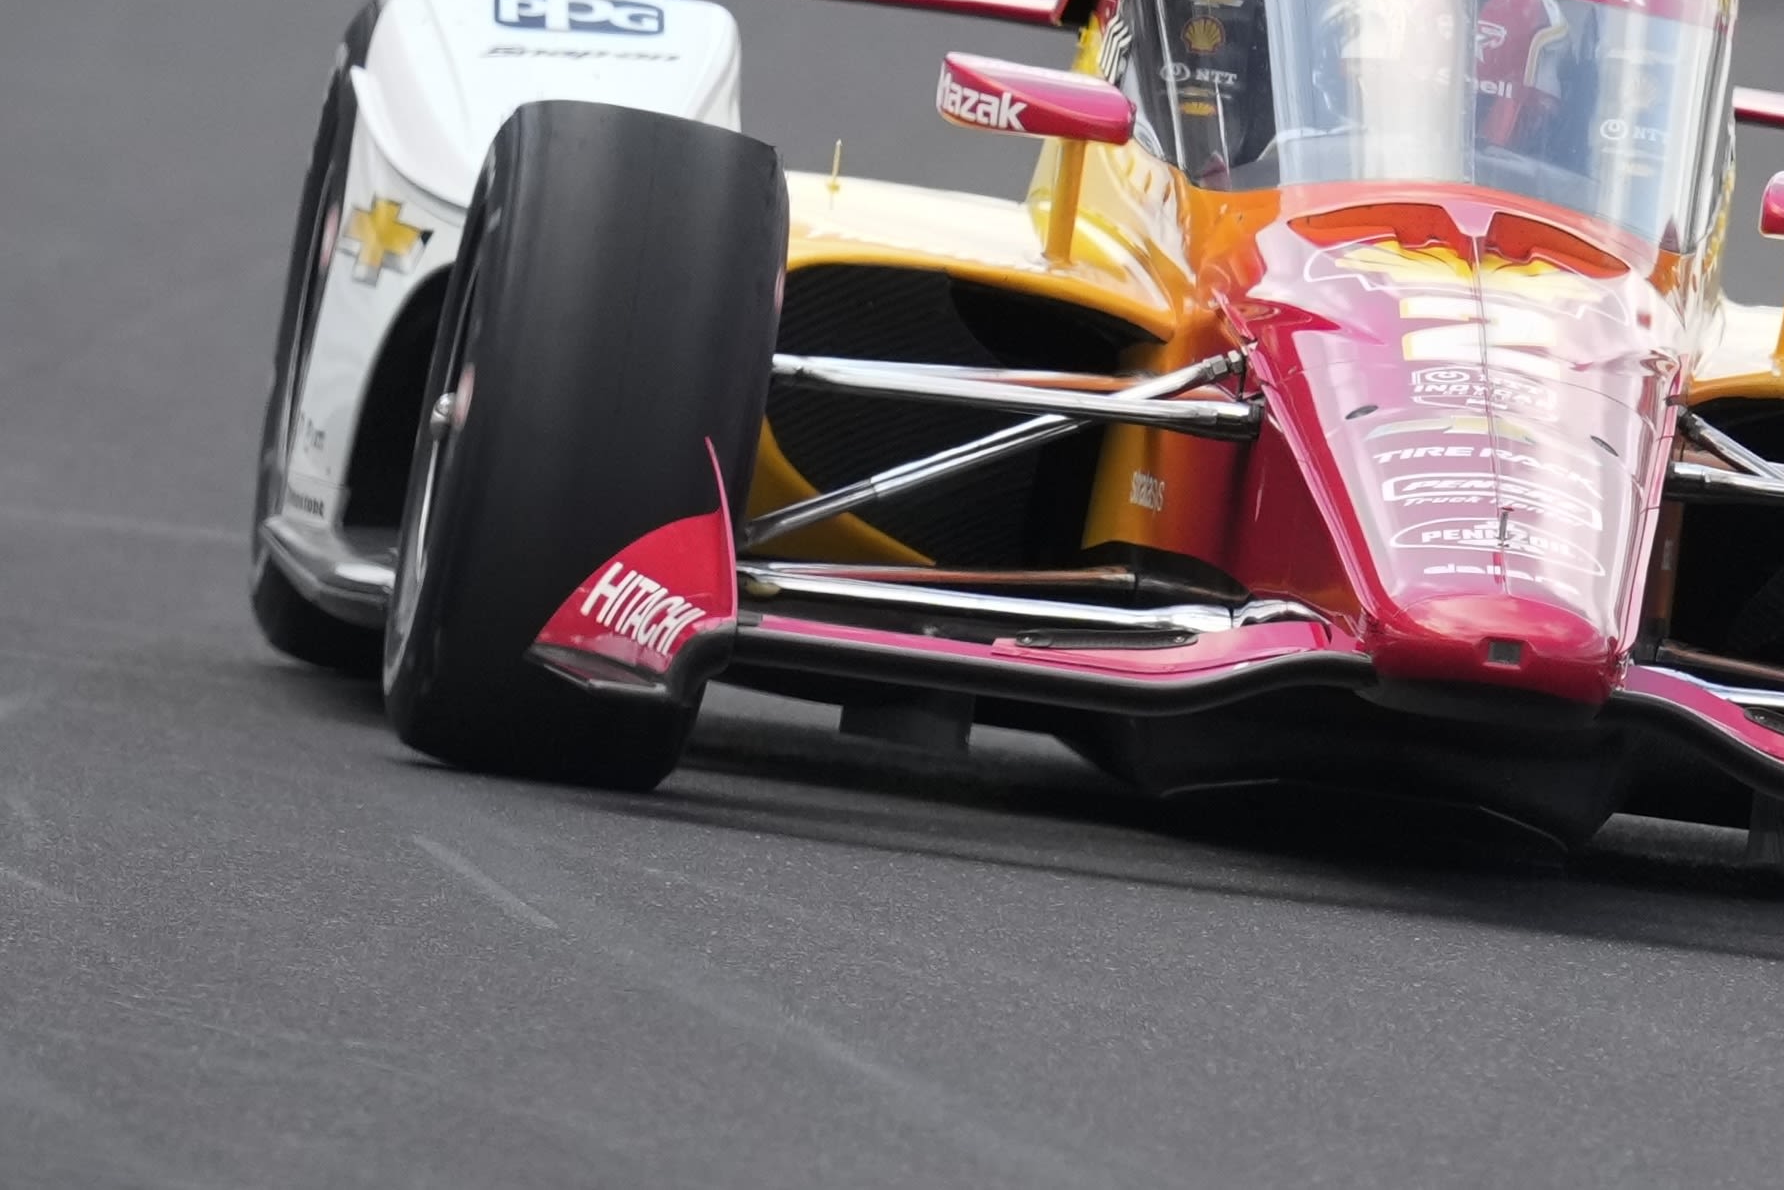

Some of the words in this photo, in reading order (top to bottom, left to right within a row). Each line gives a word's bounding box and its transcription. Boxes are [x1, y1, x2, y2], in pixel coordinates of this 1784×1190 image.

[1195, 67, 1238, 85] NTT
[1372, 445, 1481, 465] TIRE
[580, 561, 707, 656] HITACHI
